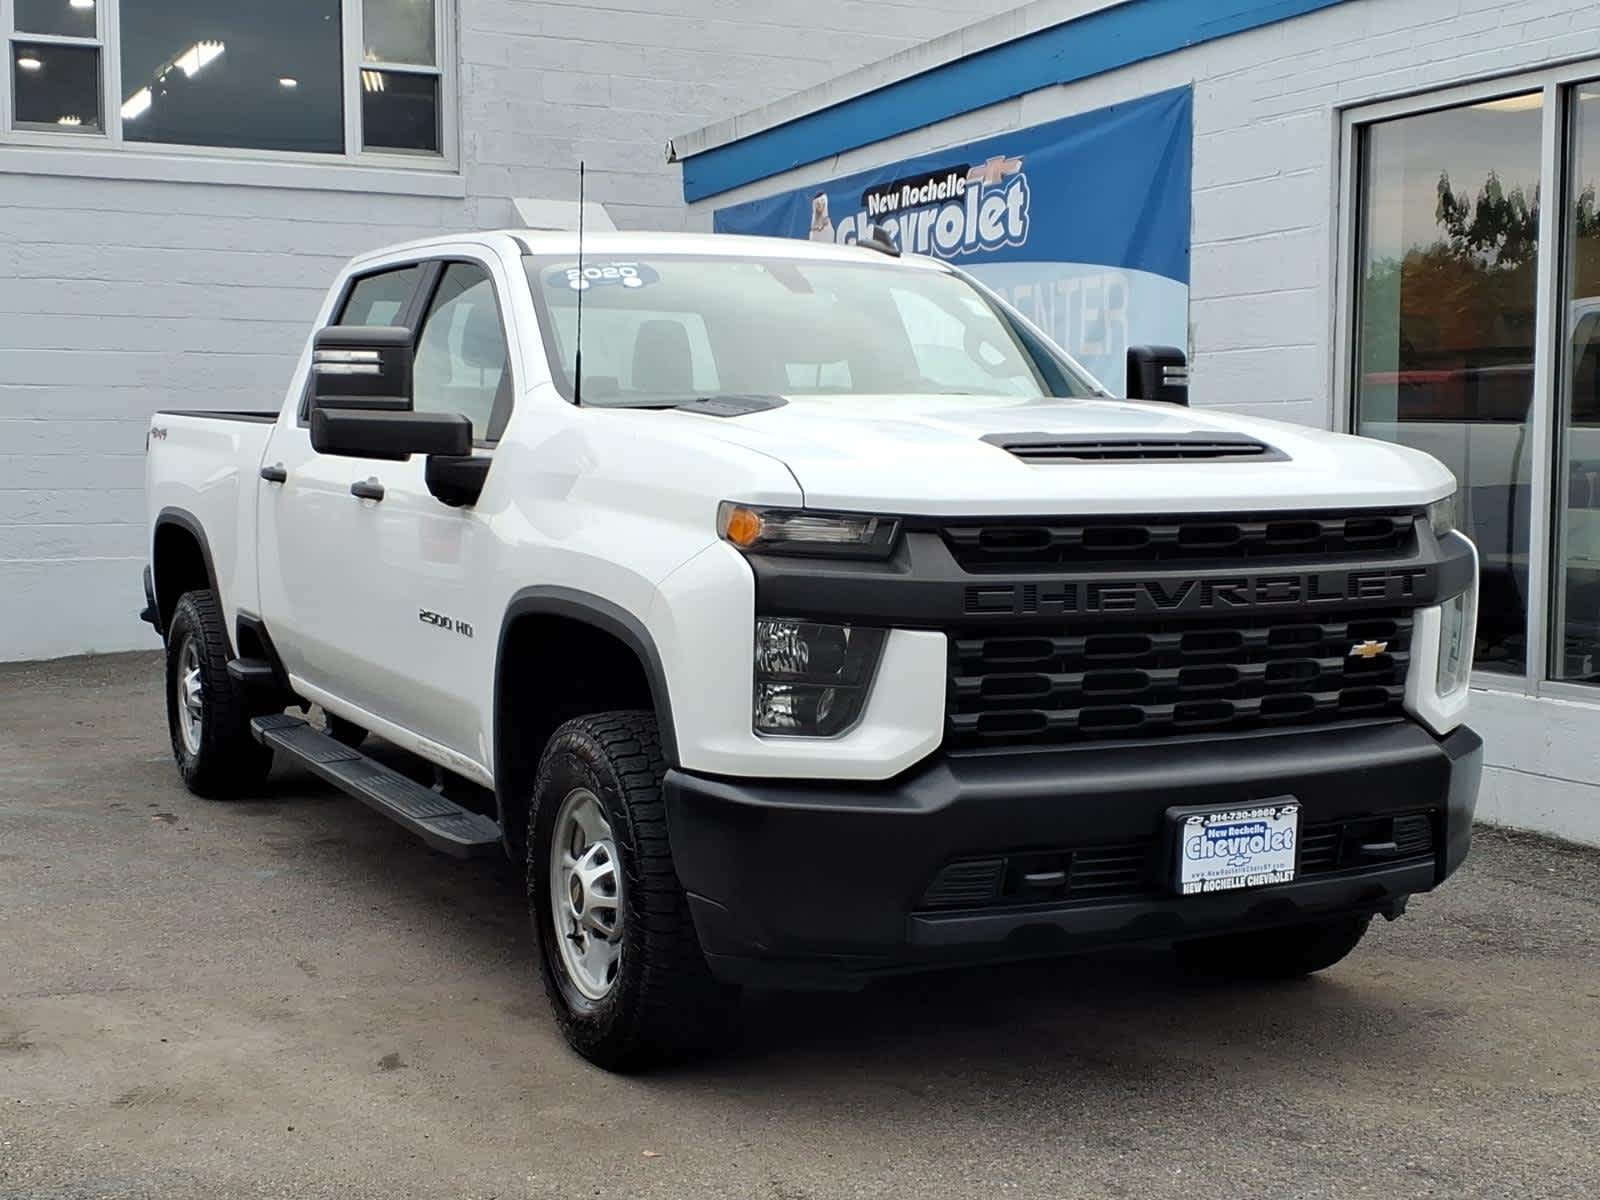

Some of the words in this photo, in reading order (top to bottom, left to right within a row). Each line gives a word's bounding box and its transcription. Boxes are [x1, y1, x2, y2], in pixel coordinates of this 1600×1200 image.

[868, 192, 900, 216] New
[902, 173, 966, 208] Rochelle
[566, 266, 638, 281] 2020
[997, 271, 1129, 356] NTER
[963, 567, 1427, 615] CHEVROLET
[419, 608, 452, 631] 2500
[455, 620, 473, 638] HD
[1185, 827, 1294, 860] Chevrolet
[1207, 828, 1228, 838] New
[1228, 824, 1265, 837] Rochelle
[1183, 882, 1202, 894] NEW
[1203, 875, 1246, 892] ROCHELLE
[1247, 870, 1295, 886] CHEVROLET
